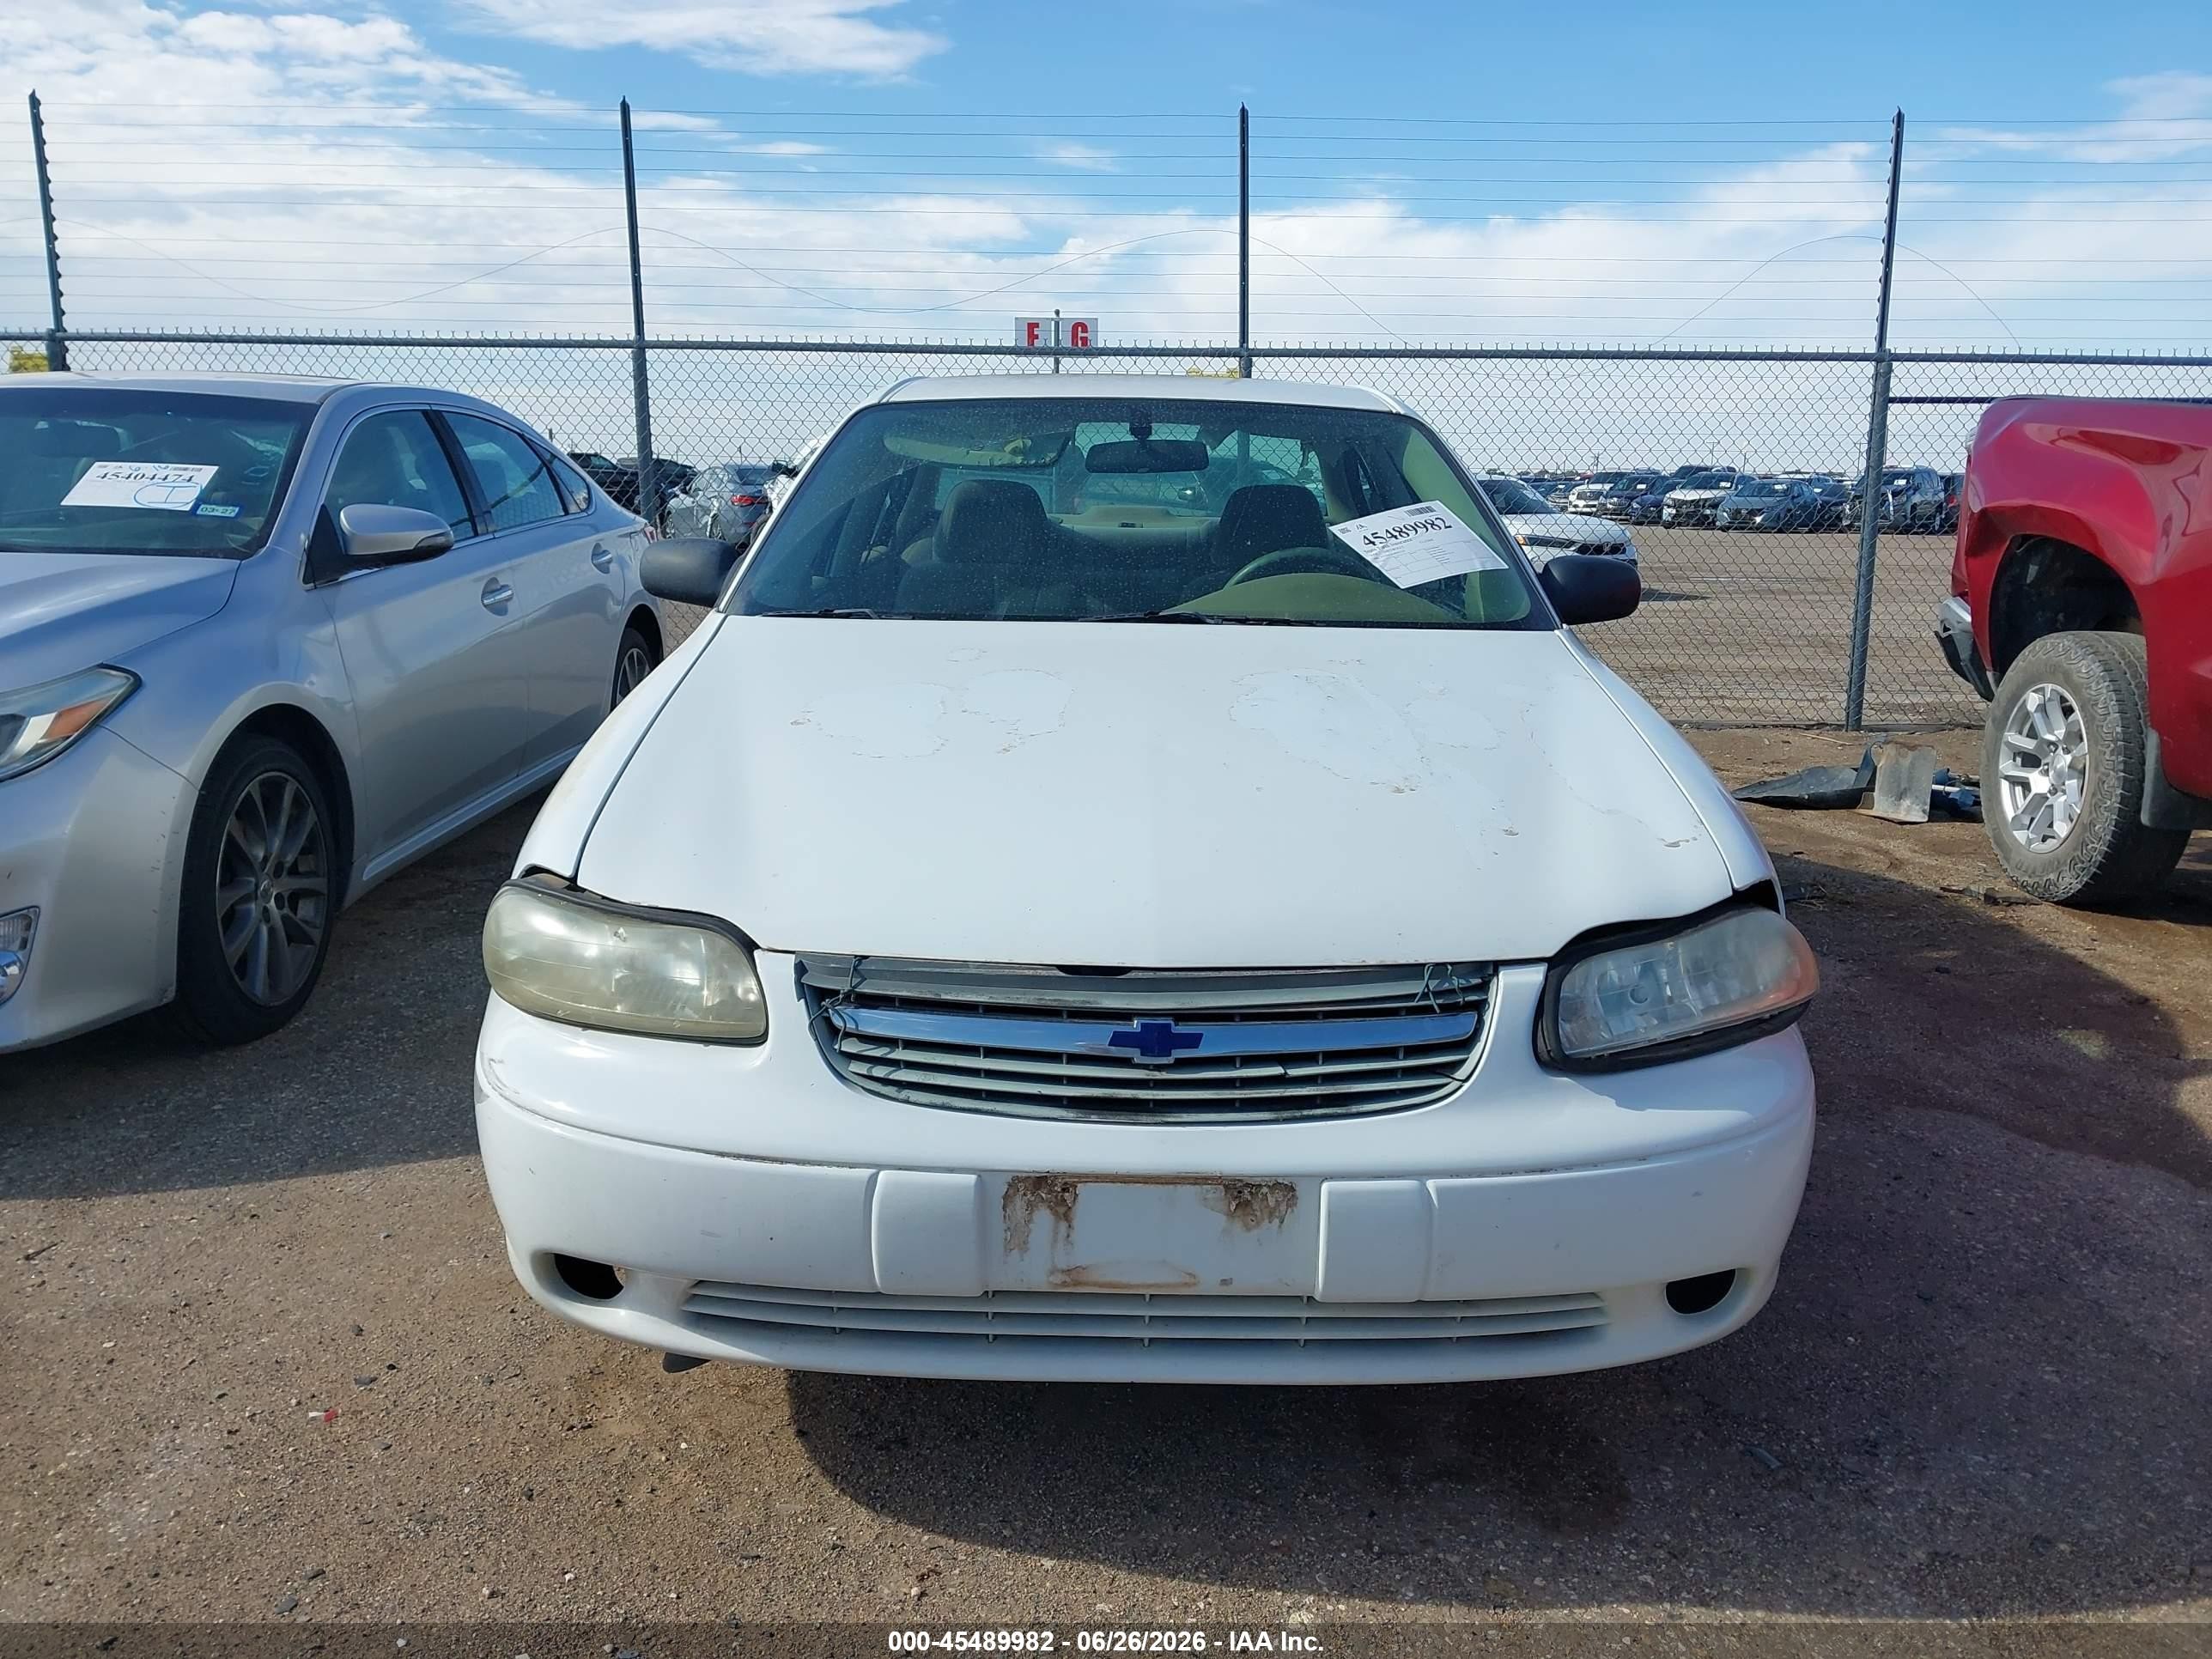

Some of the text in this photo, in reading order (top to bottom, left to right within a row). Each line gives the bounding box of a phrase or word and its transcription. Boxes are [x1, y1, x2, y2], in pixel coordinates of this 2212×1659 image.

[1026, 322, 1040, 348] F
[1071, 321, 1089, 348] G
[96, 471, 195, 483] 45404474
[1363, 517, 1453, 546] 45489982
